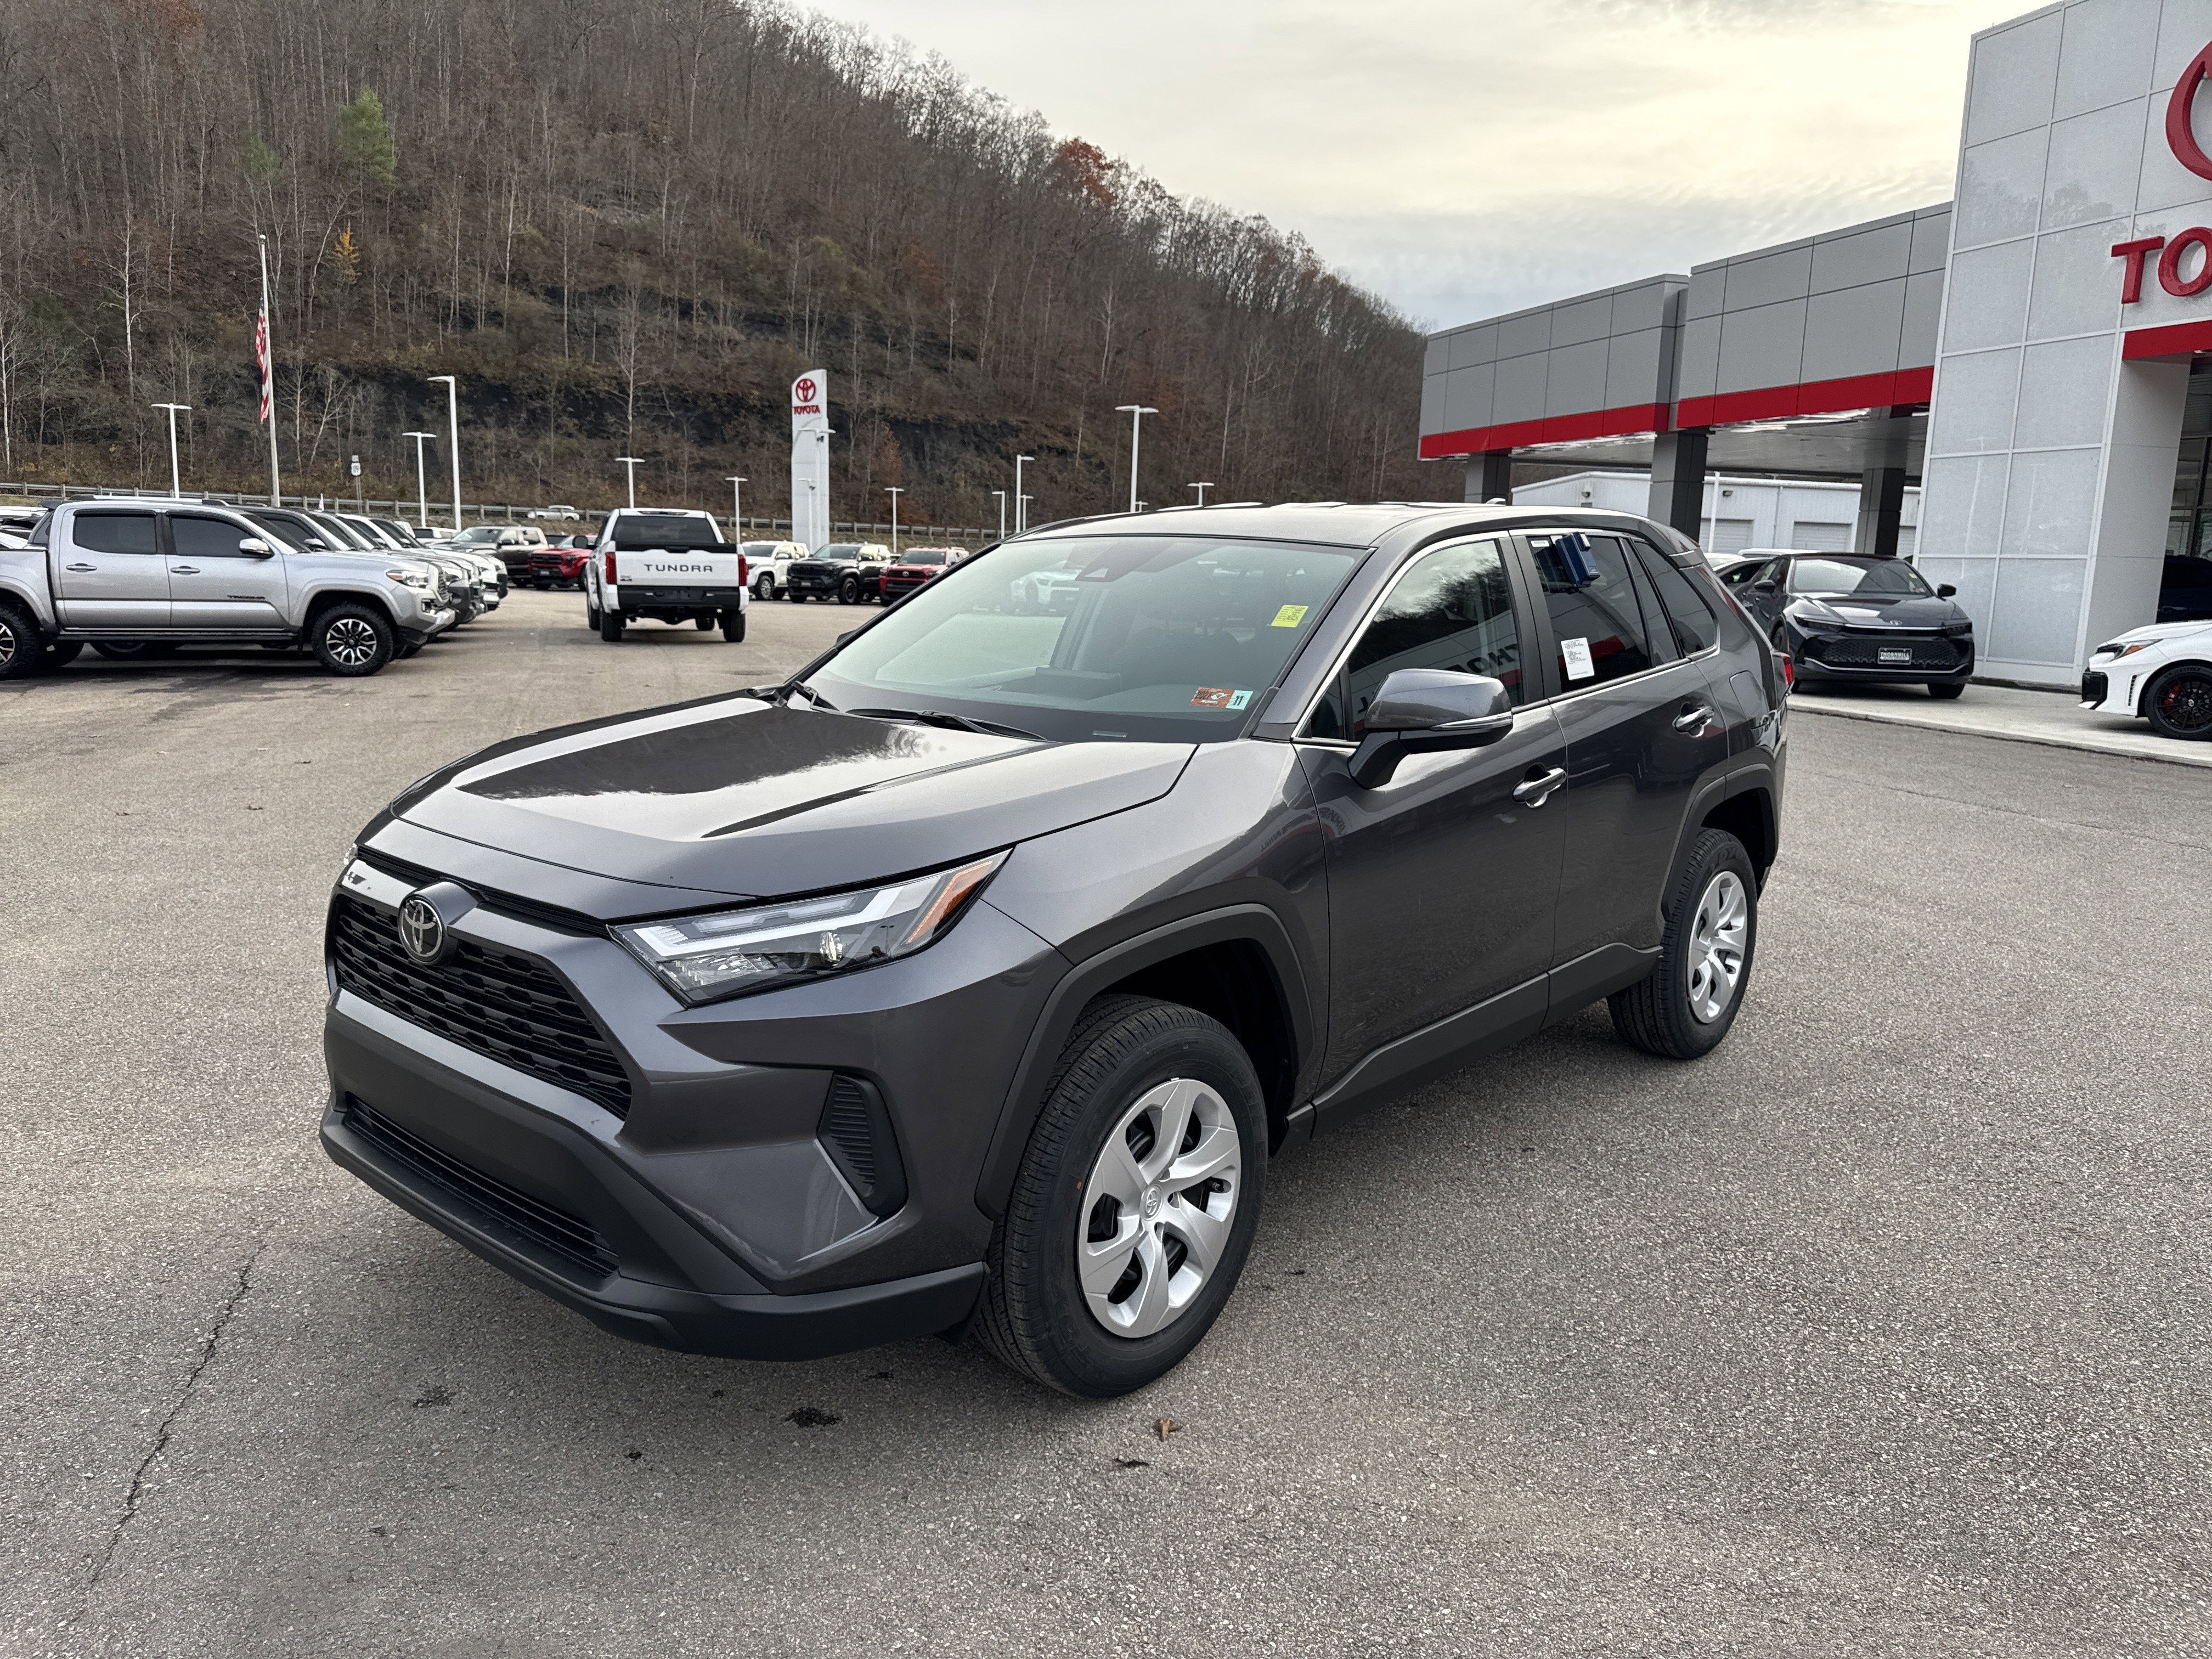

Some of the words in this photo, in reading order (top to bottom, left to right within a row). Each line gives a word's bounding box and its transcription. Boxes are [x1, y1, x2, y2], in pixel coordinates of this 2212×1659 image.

[2111, 227, 2212, 304] TO
[793, 405, 821, 415] TOYOTA
[644, 564, 713, 573] TUNDRA
[1233, 695, 1244, 706] 11
